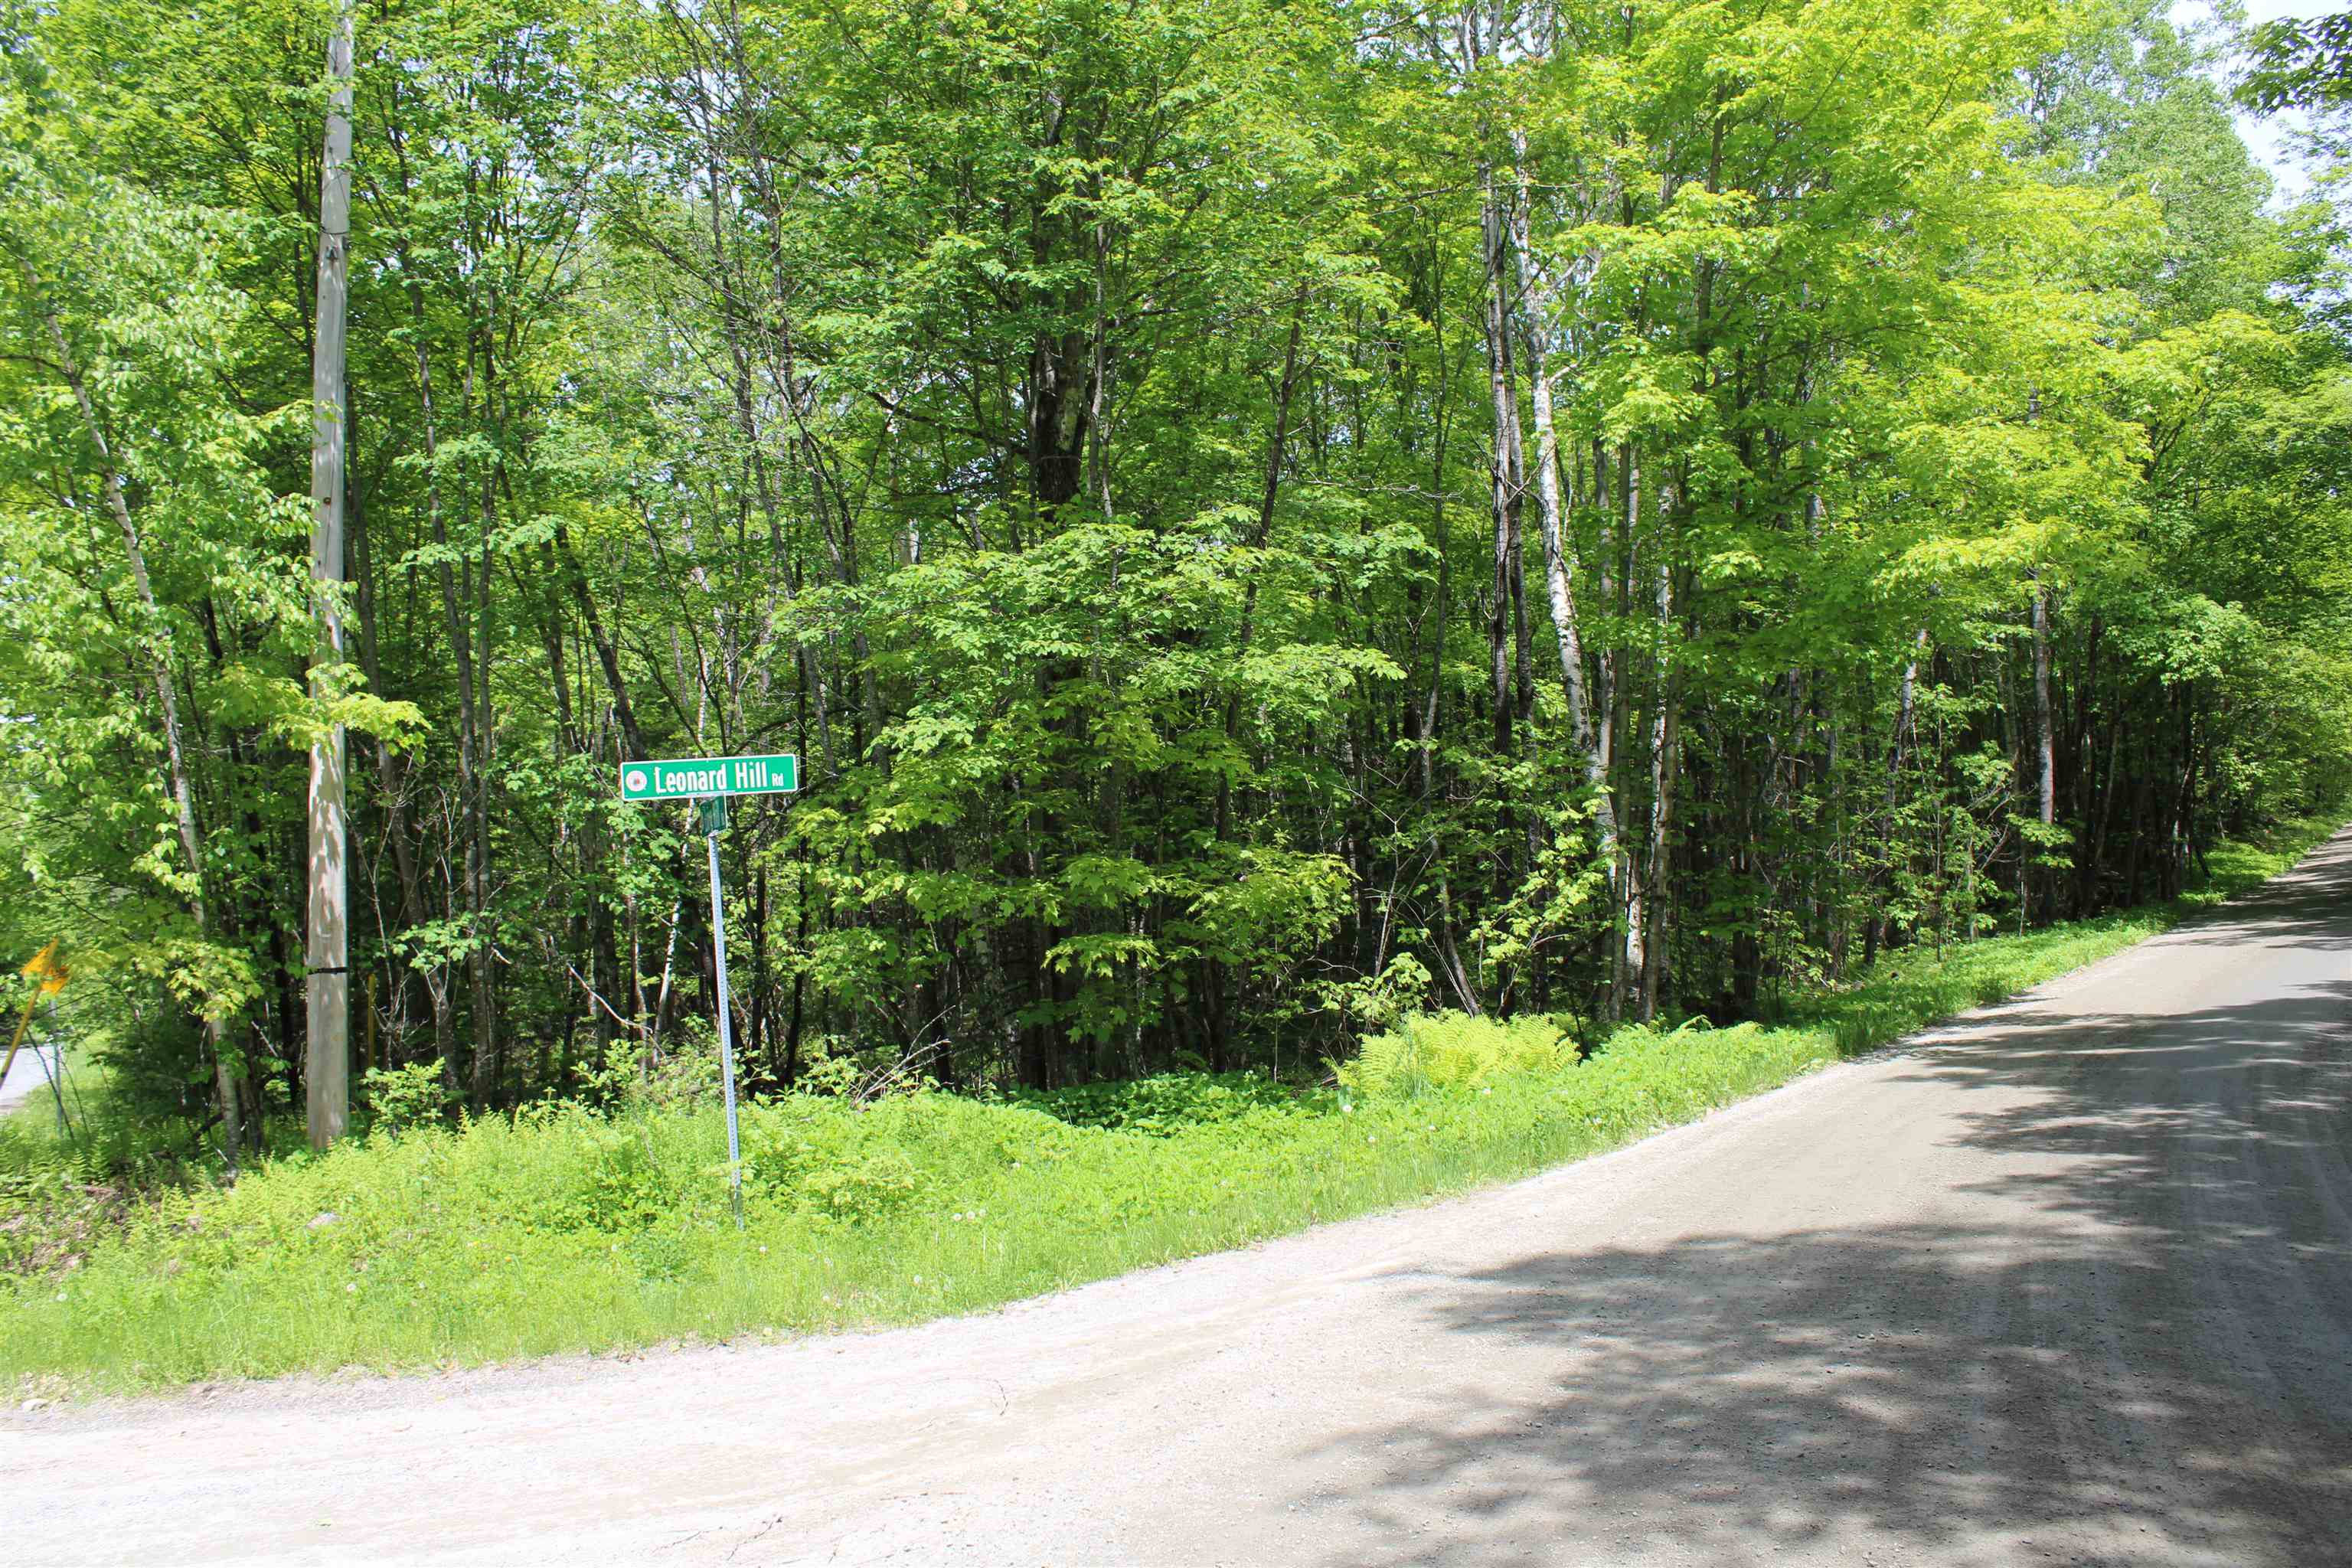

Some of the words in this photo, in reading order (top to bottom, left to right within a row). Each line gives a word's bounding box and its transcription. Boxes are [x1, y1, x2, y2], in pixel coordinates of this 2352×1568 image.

[655, 764, 726, 793] Leonard
[735, 762, 767, 789] Hill
[772, 773, 784, 787] Rd
